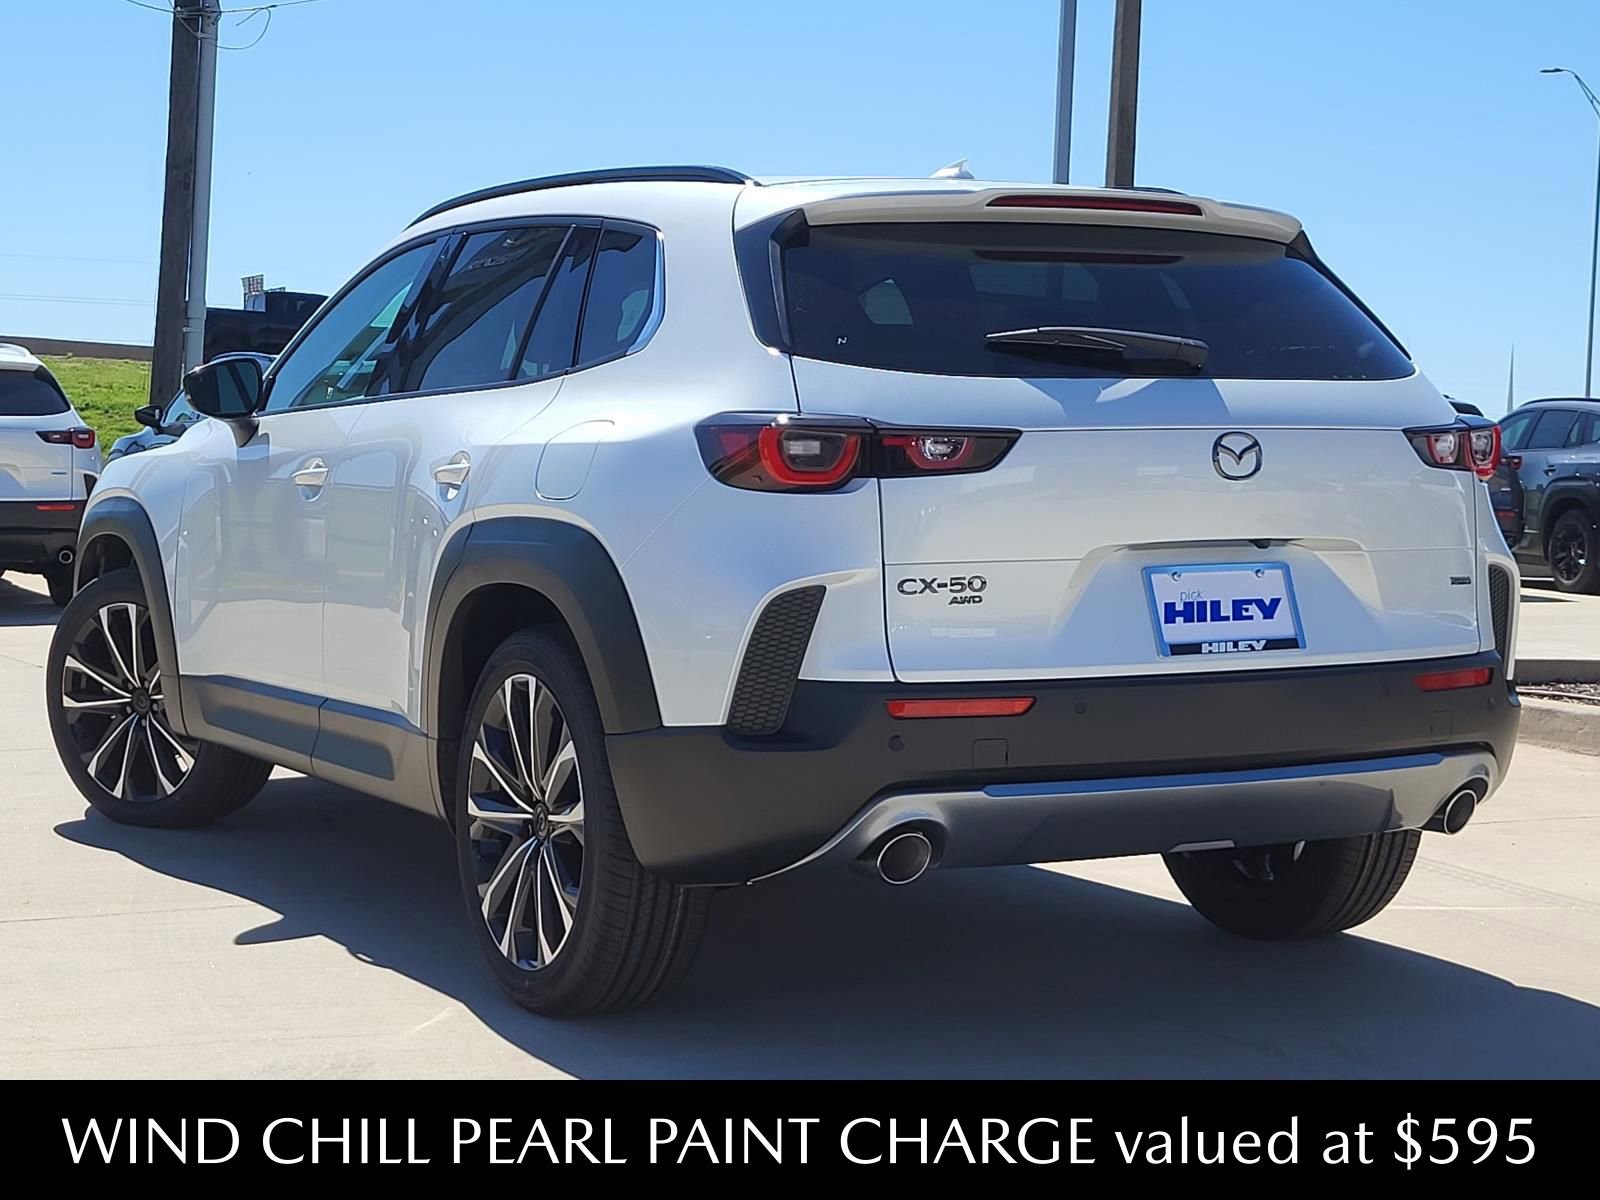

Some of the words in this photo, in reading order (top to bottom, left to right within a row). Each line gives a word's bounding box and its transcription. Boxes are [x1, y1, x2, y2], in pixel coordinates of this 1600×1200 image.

[897, 575, 987, 596] CX-50
[948, 595, 983, 606] AWD
[1163, 597, 1282, 625] HILEY
[1201, 639, 1267, 654] HILEY
